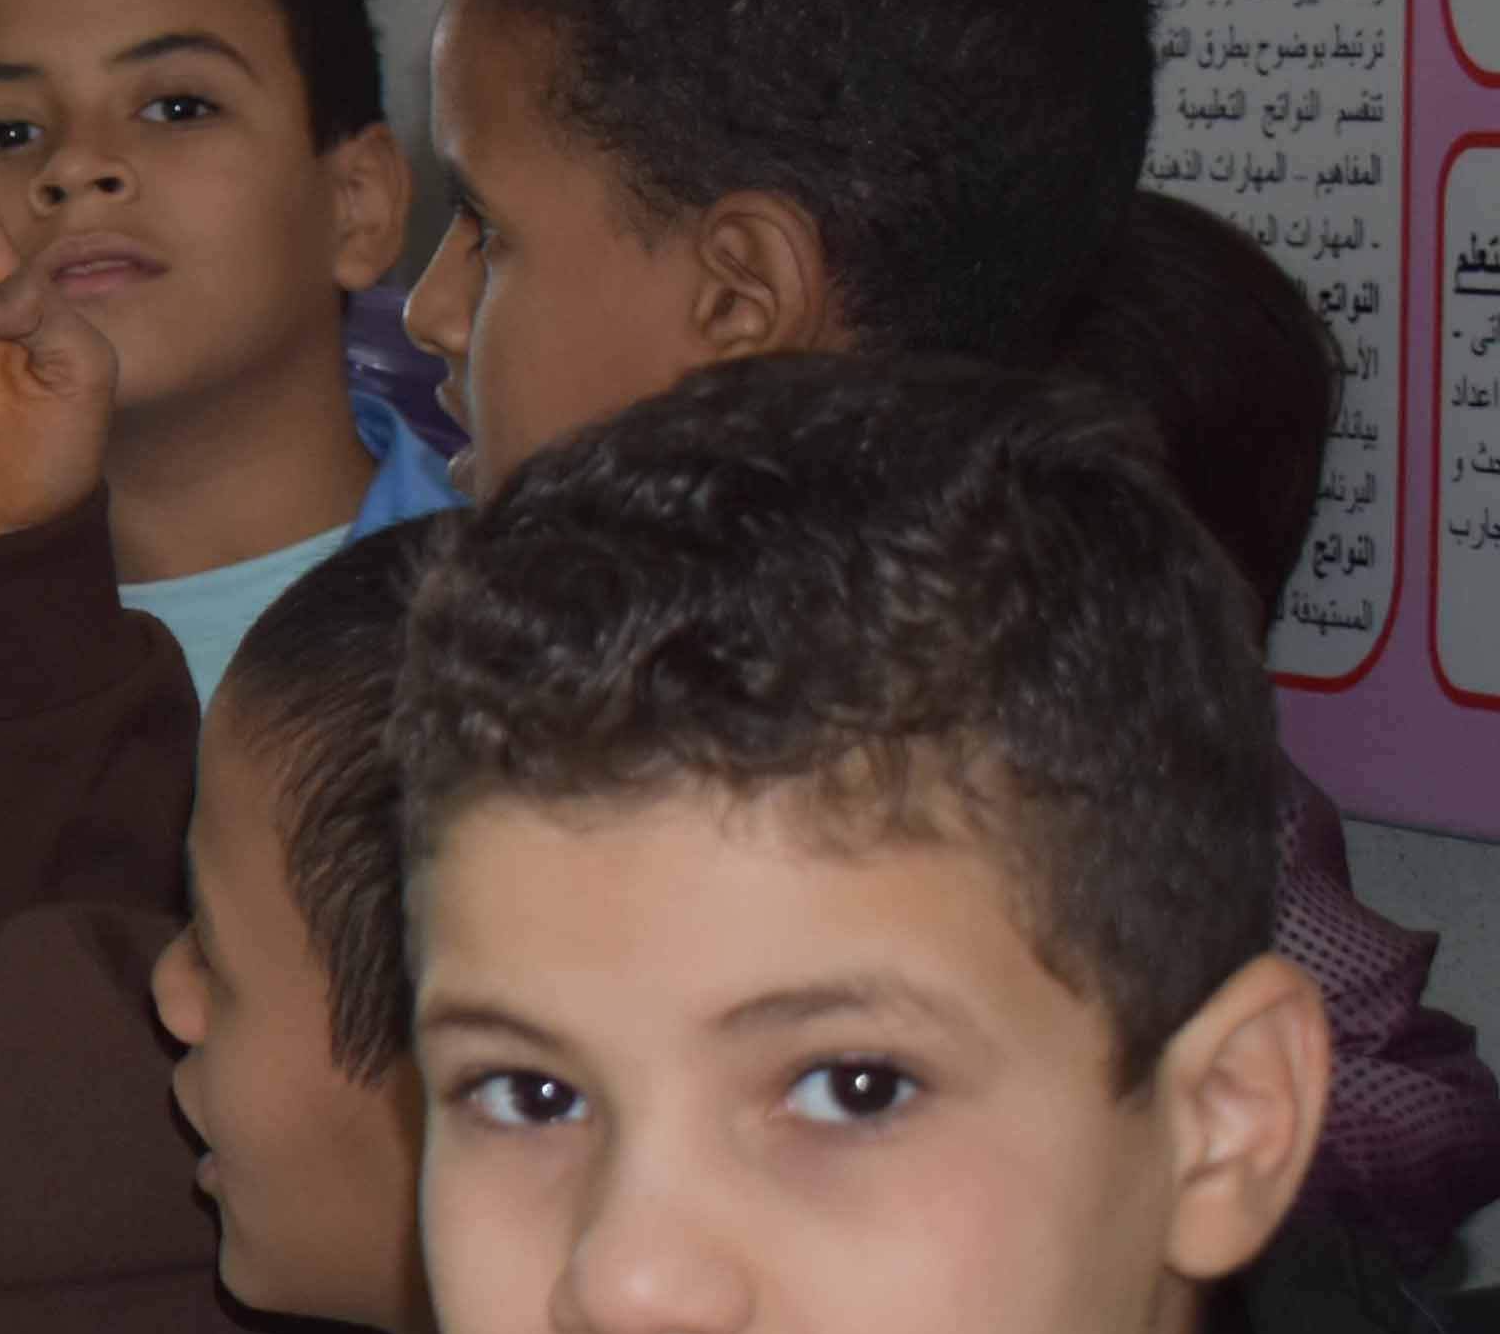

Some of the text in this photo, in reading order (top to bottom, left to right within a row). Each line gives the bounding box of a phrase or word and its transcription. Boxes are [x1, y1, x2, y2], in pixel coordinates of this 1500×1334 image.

[1197, 24, 1251, 70] بطرق
[1256, 32, 1327, 76] بوضوح
[1331, 24, 1385, 70] ترتبط
[1177, 87, 1385, 139] تنقسم النواتج التعليمية
[1209, 150, 1287, 194] المهارات
[1315, 152, 1381, 203] المفاهيم
[1285, 215, 1364, 260] المهارات
[1312, 534, 1374, 580] النواتج
[1290, 589, 1373, 636] المستهدفة
